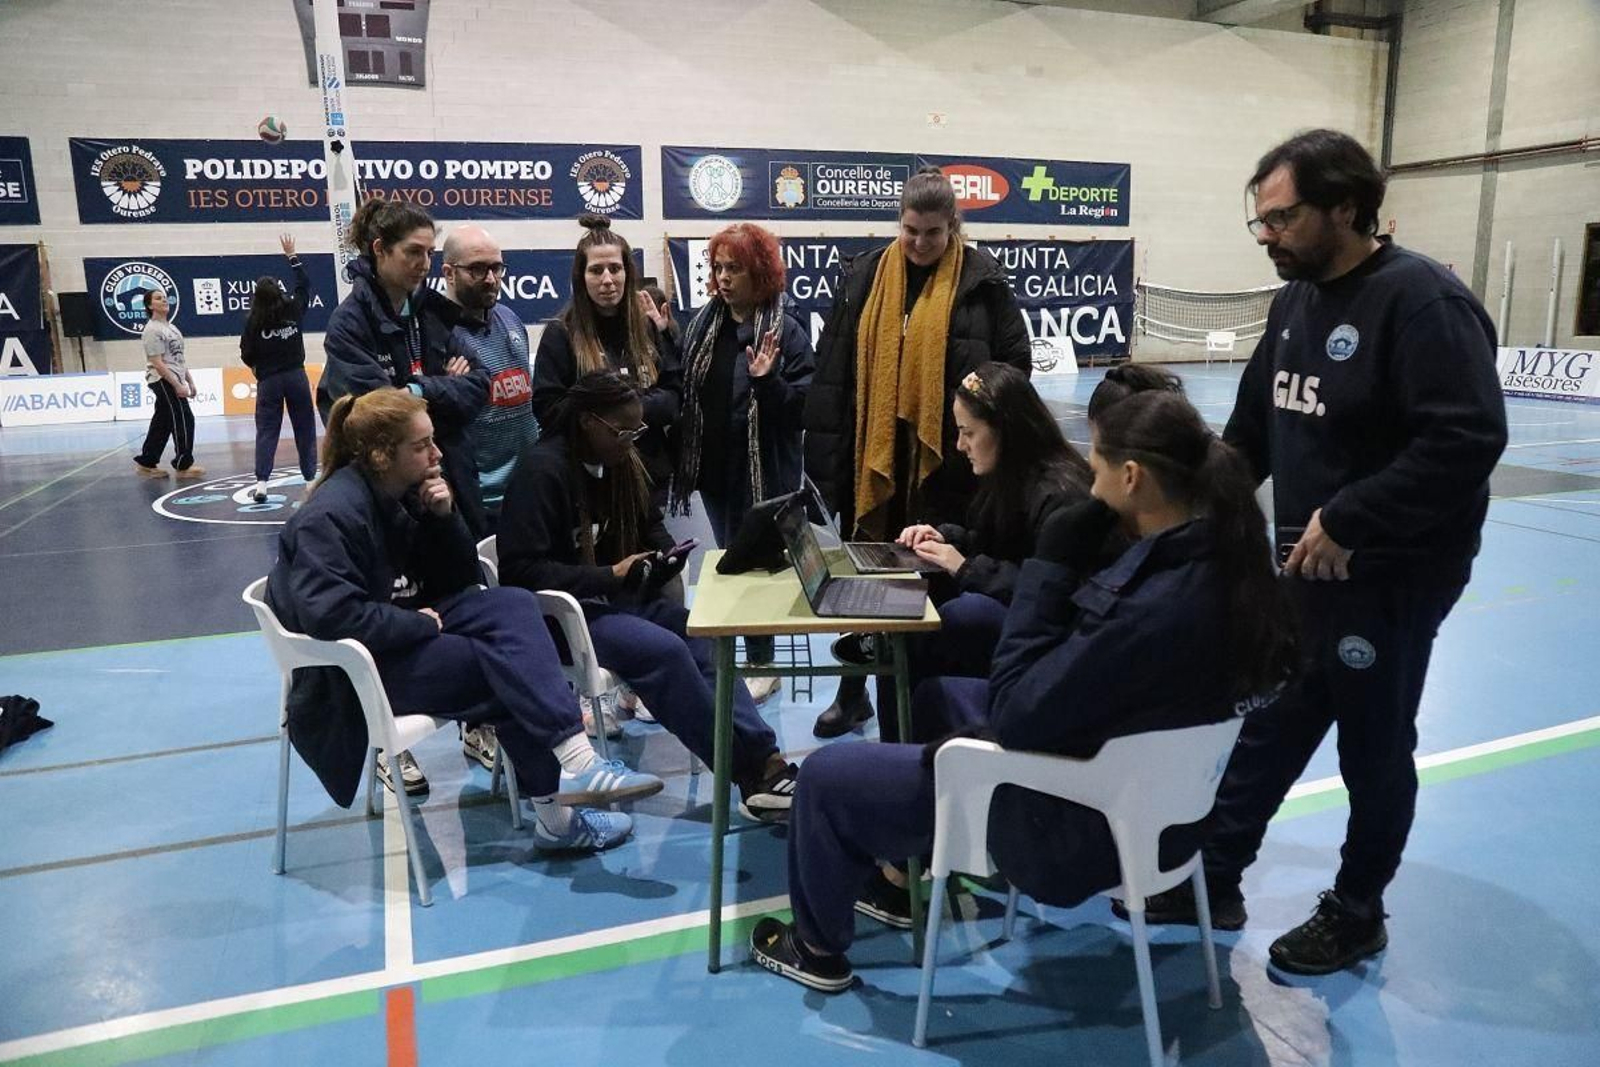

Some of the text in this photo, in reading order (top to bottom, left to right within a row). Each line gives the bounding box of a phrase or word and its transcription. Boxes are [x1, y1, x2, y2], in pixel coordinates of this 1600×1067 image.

[91, 145, 167, 177] IES Otero Pedrayo
[578, 151, 603, 164] Otero
[184, 159, 553, 180] POLIDEPOTIVO O POMPEO
[816, 165, 892, 180] Concello de
[816, 180, 903, 196] OURENSE
[950, 174, 1000, 201] BRIL
[188, 189, 229, 208] IES
[235, 188, 318, 208] OTERO
[444, 188, 553, 207] OURENSE
[112, 204, 157, 218] Ourense
[584, 202, 620, 214] Ourense
[1060, 204, 1077, 216] La
[105, 265, 173, 293] CLUB VOLEIBOL
[1025, 274, 1118, 297] GALICIA
[228, 297, 251, 311] DE
[1509, 350, 1593, 380] MYG
[492, 373, 533, 403] ABRIL
[1504, 375, 1582, 392] asesores
